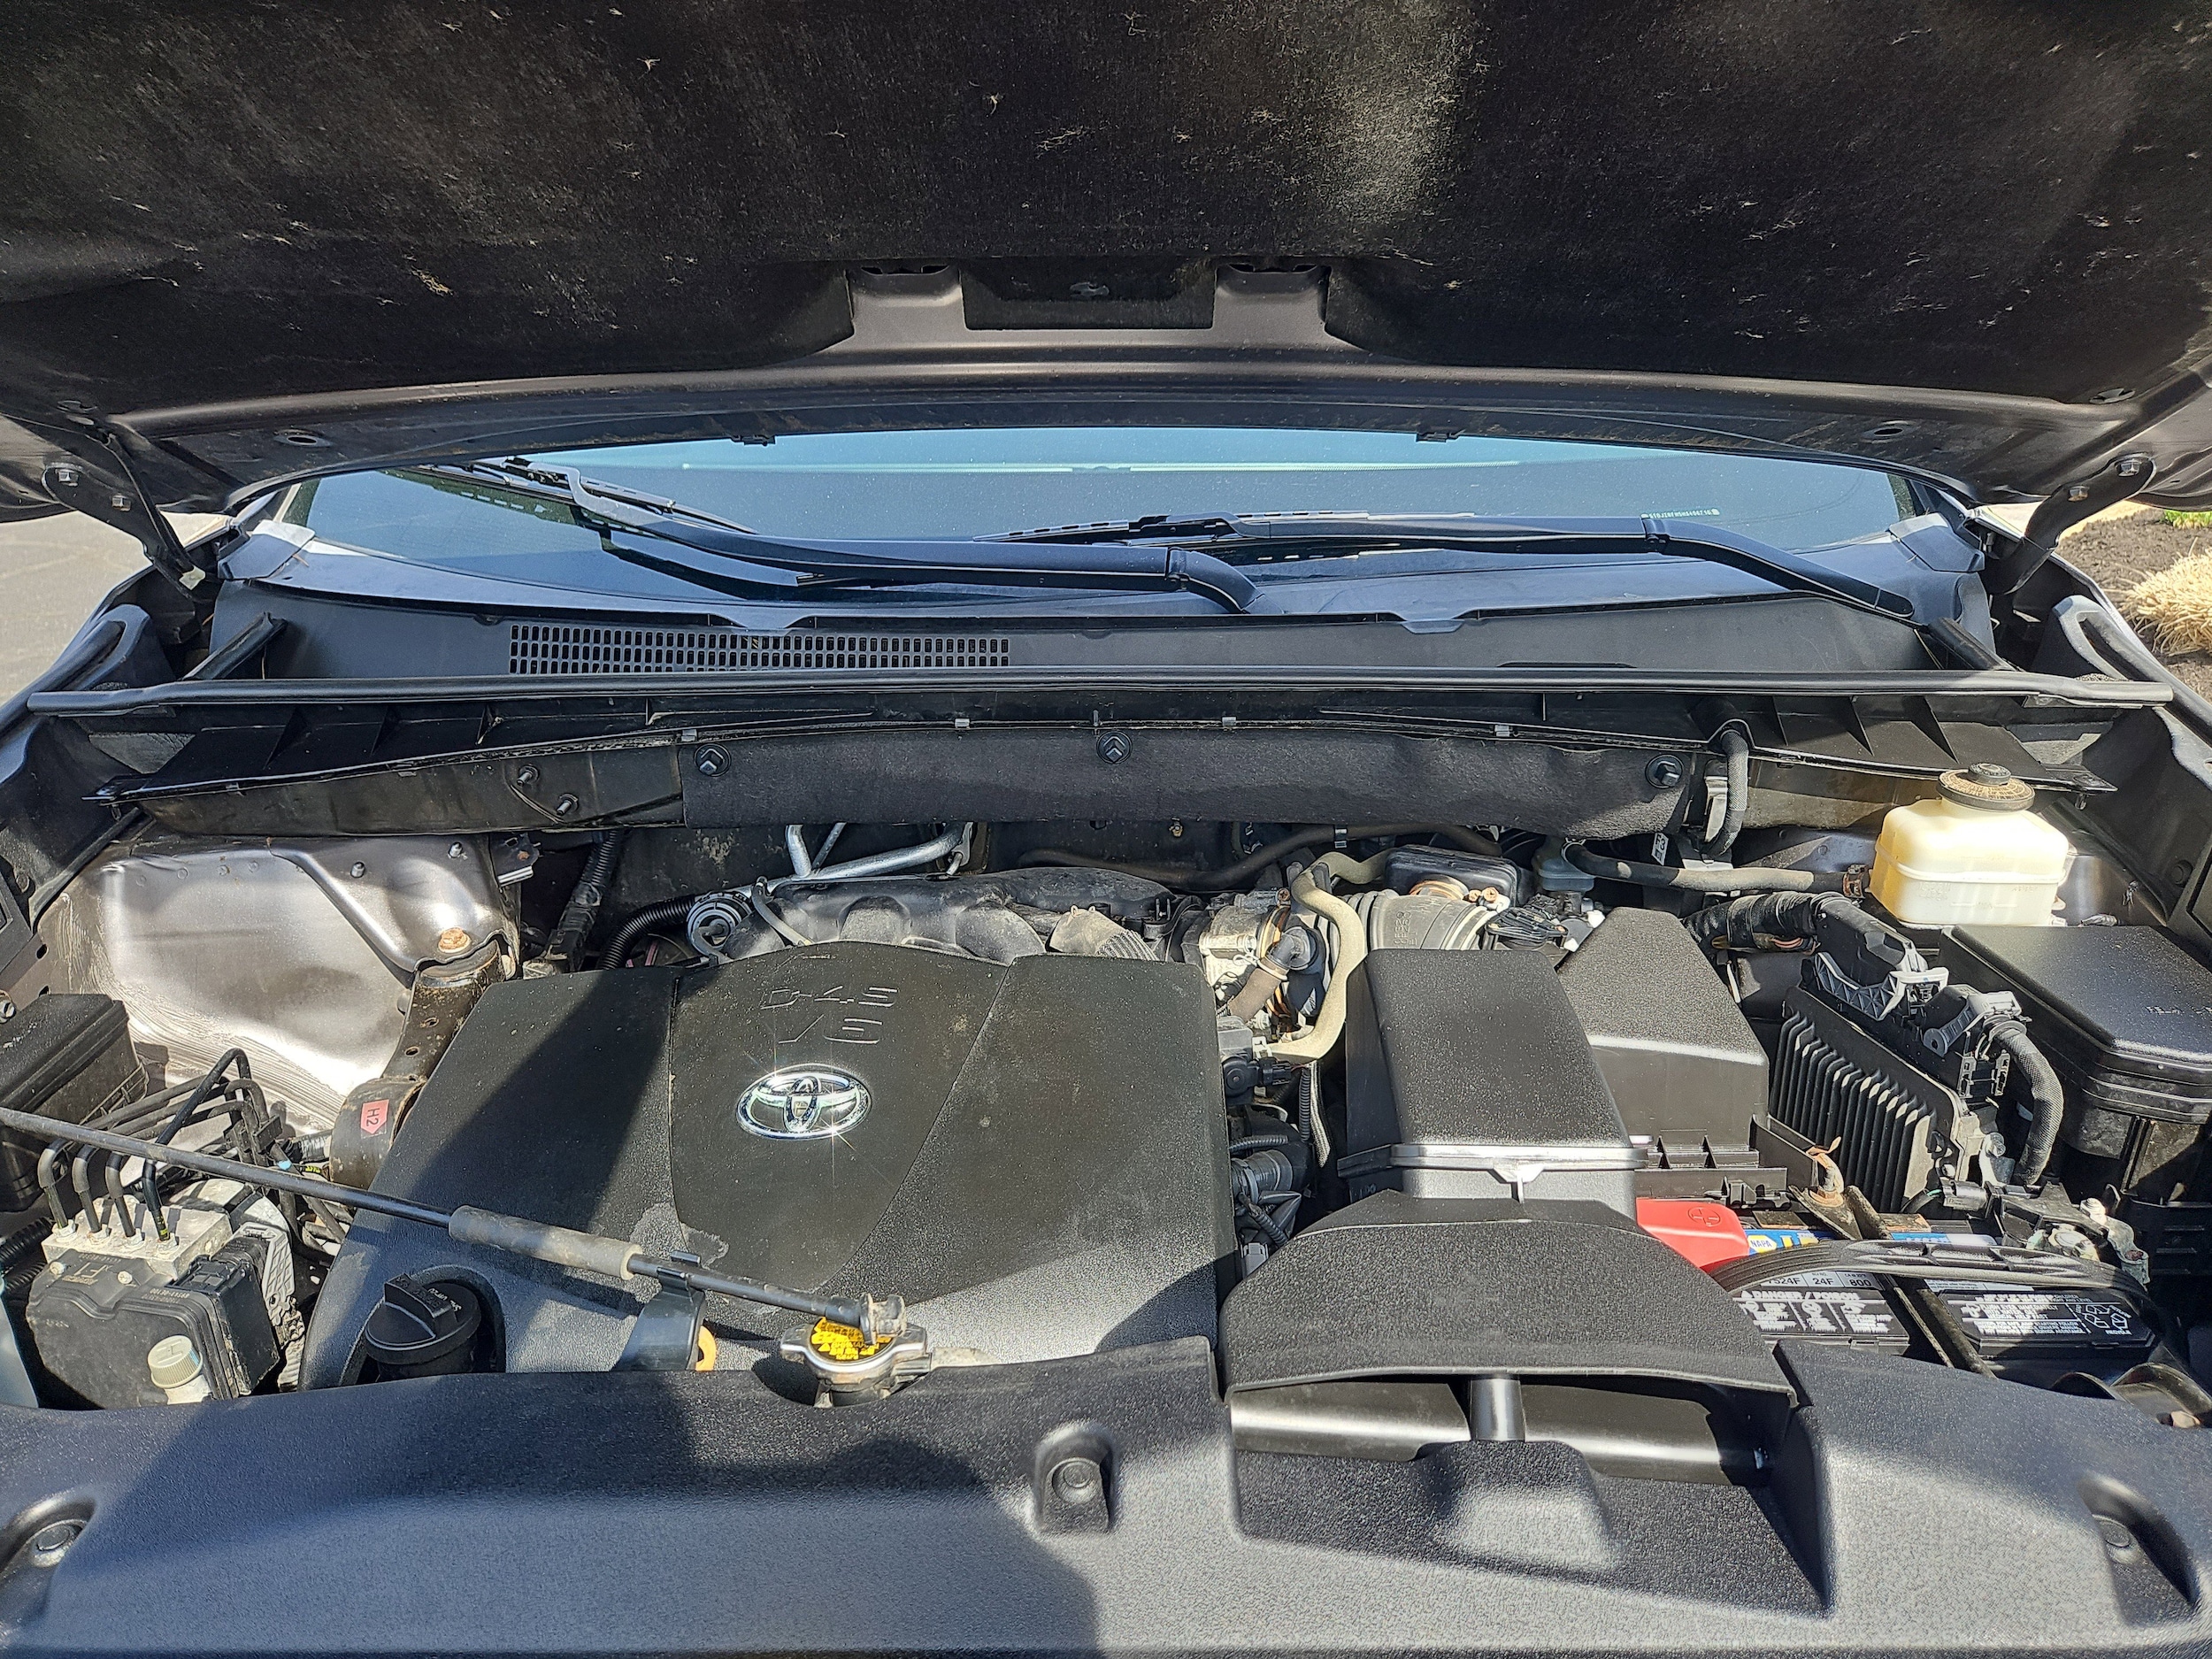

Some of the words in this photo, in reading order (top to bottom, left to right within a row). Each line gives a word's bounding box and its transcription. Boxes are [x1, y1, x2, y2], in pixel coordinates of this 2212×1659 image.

[365, 1107, 380, 1127] H2
[1749, 1239, 1772, 1248] NAPA
[1812, 1277, 1834, 1286] 24F
[1753, 1290, 1802, 1300] DANGER
[1812, 1291, 1860, 1301] POISON
